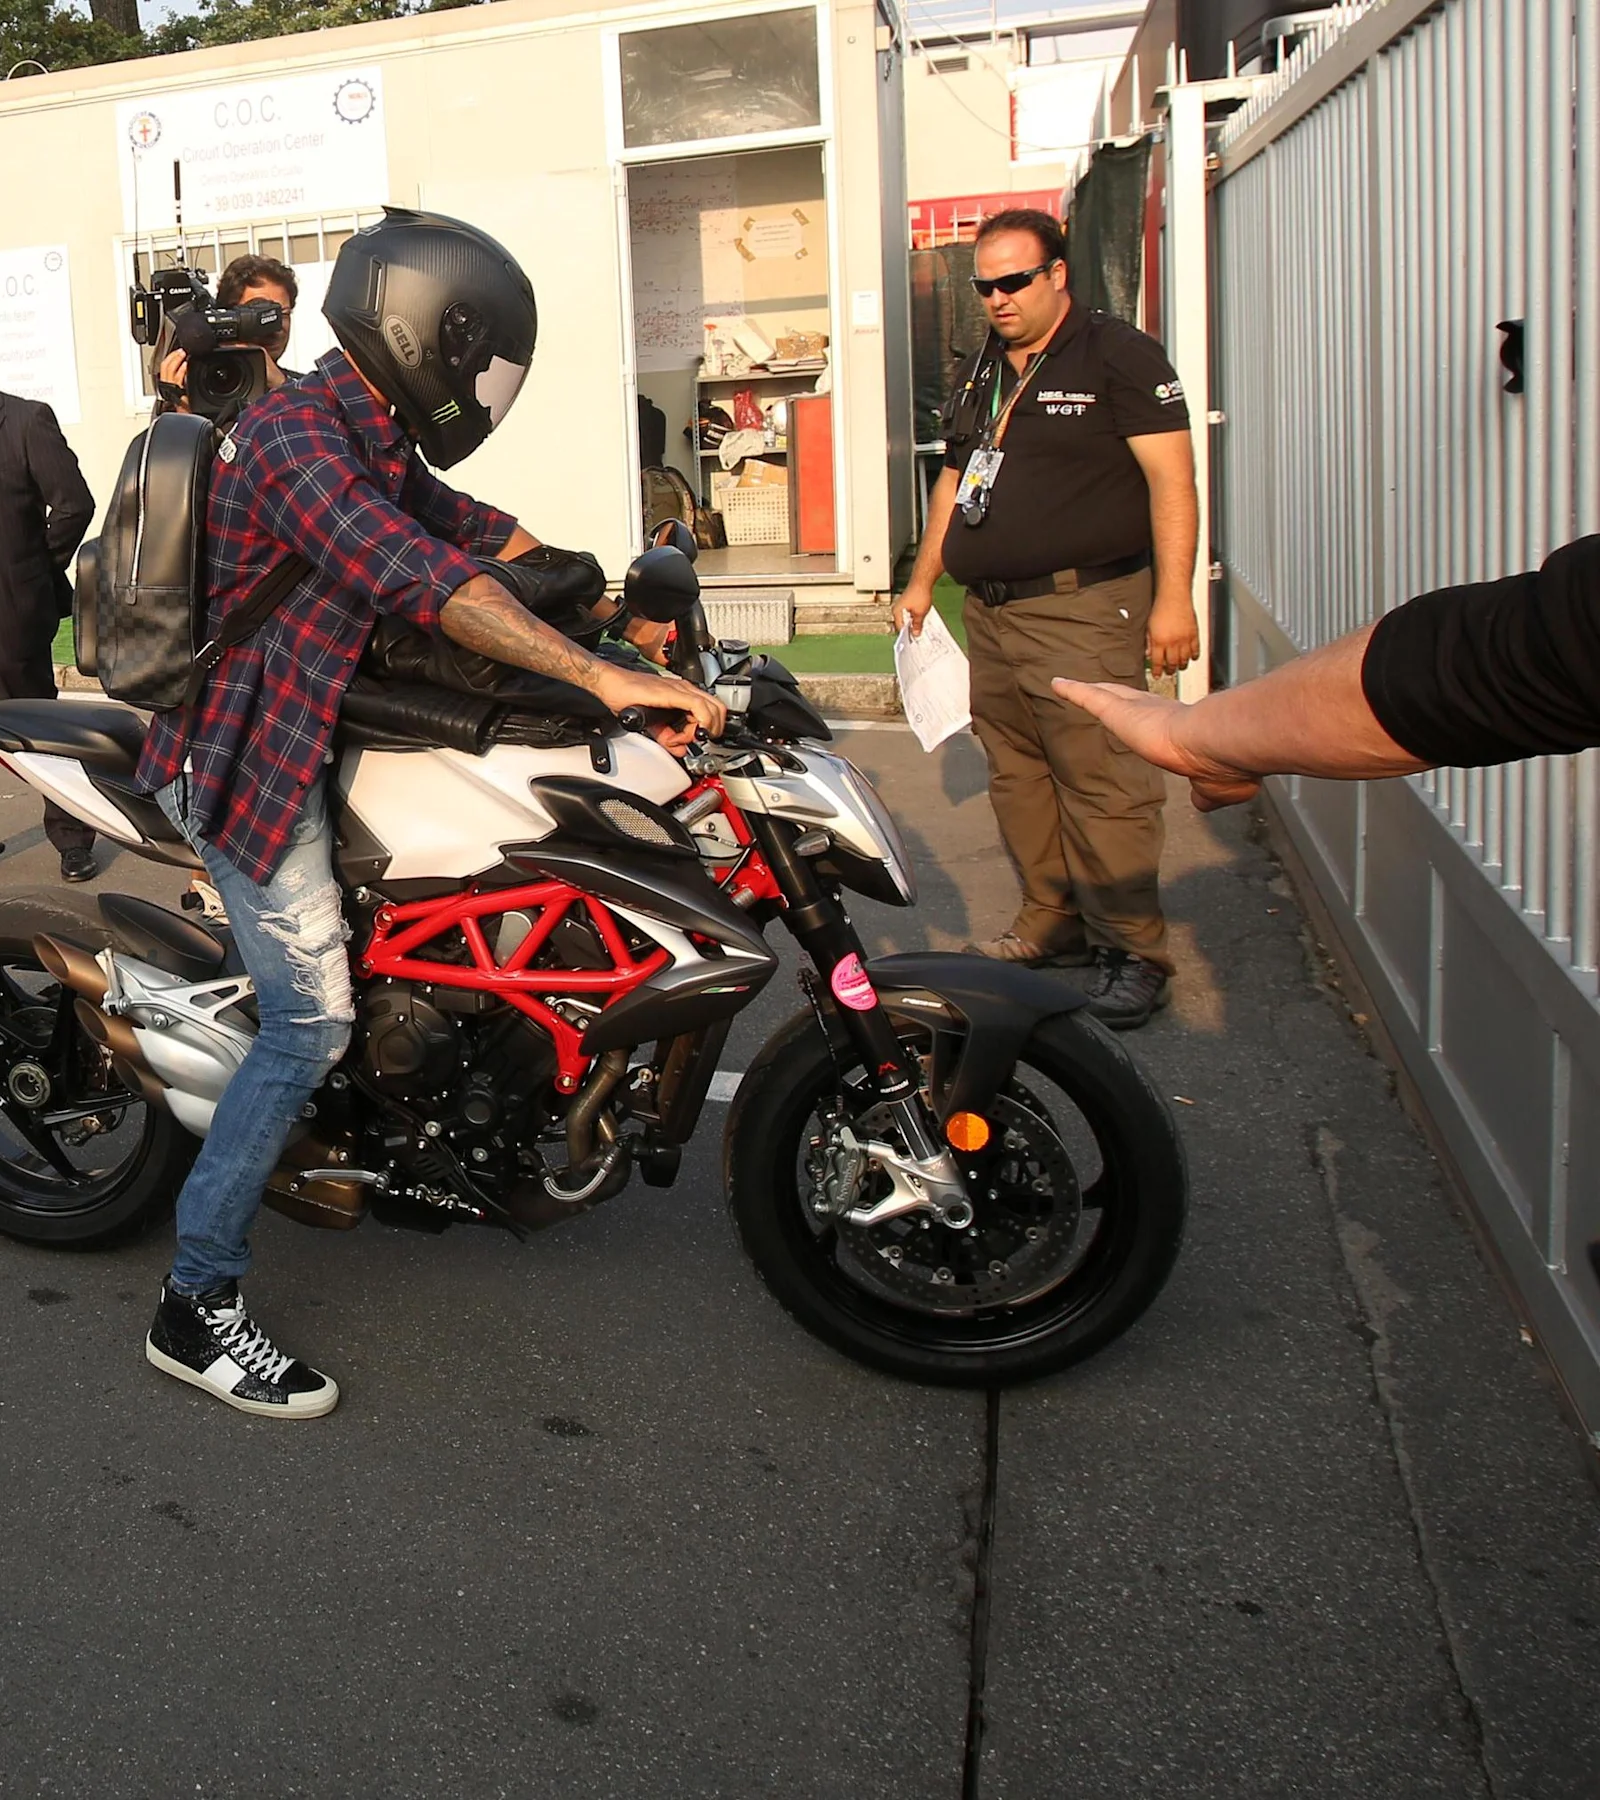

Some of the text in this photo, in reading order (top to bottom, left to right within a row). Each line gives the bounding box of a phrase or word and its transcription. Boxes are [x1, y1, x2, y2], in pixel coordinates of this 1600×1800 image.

[213, 94, 282, 129] C.O.C.
[182, 131, 325, 163] Circuit Operation Center
[215, 195, 230, 212] 39
[390, 323, 415, 362] BELL
